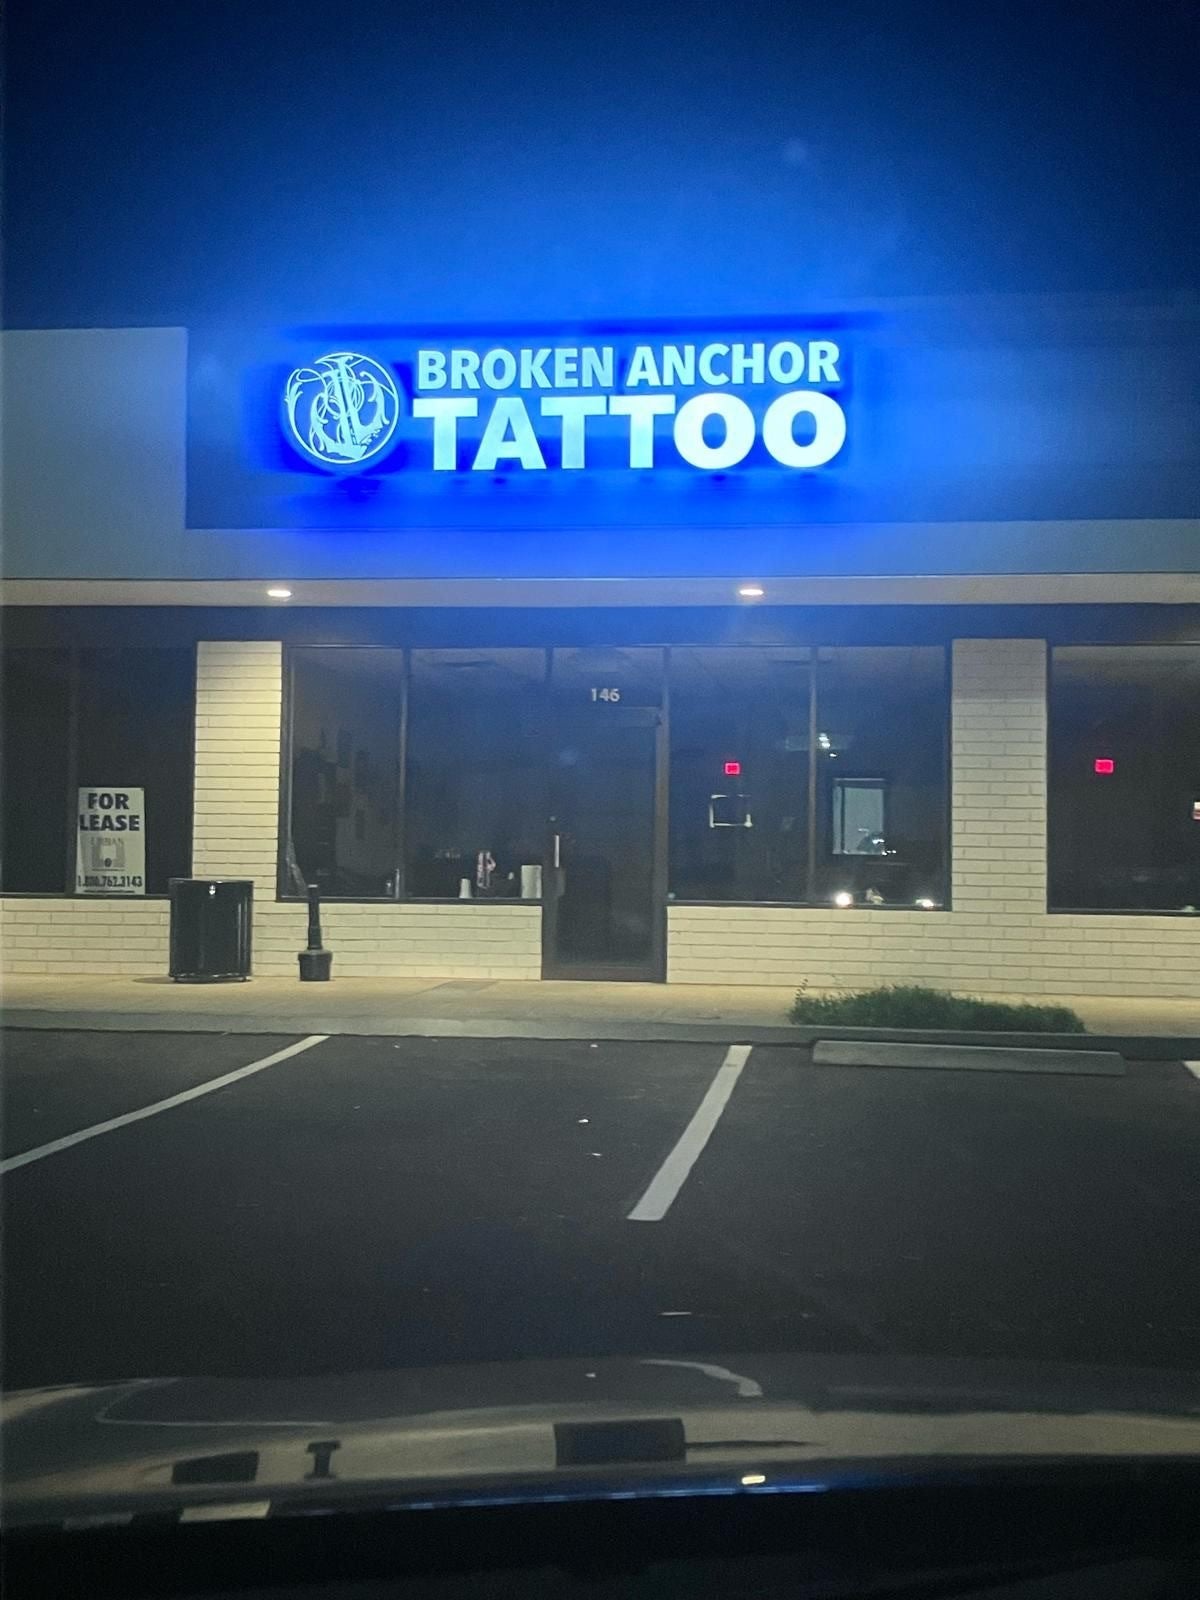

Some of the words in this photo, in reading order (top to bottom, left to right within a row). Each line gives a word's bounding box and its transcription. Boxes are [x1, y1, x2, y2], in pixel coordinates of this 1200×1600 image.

[418, 347, 613, 390] BROKEN
[626, 341, 840, 387] ANCHOR
[413, 389, 846, 470] TATTOO
[88, 793, 129, 809] FOR
[80, 815, 139, 831] LEASE
